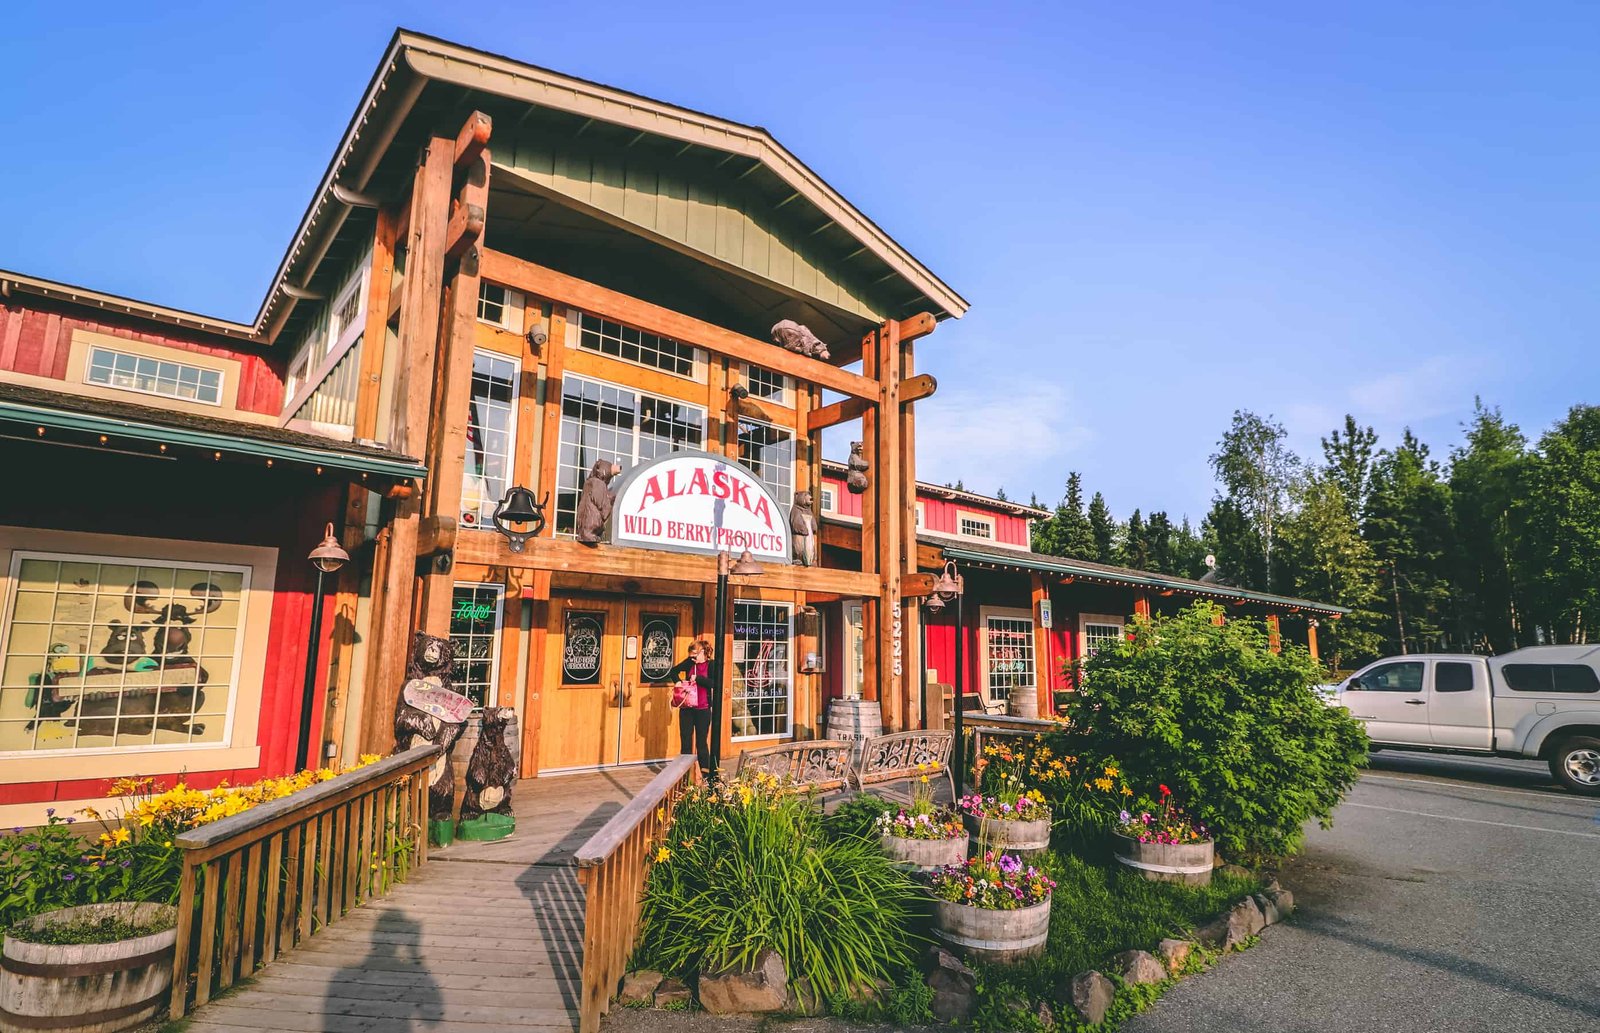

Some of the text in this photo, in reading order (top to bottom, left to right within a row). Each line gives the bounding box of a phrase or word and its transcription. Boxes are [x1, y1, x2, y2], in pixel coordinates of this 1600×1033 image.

[637, 467, 774, 532] ALASKA
[624, 514, 783, 552] WILD BERRY PRODUCTS
[892, 601, 902, 676] 5225
[837, 733, 865, 742] TRASH
